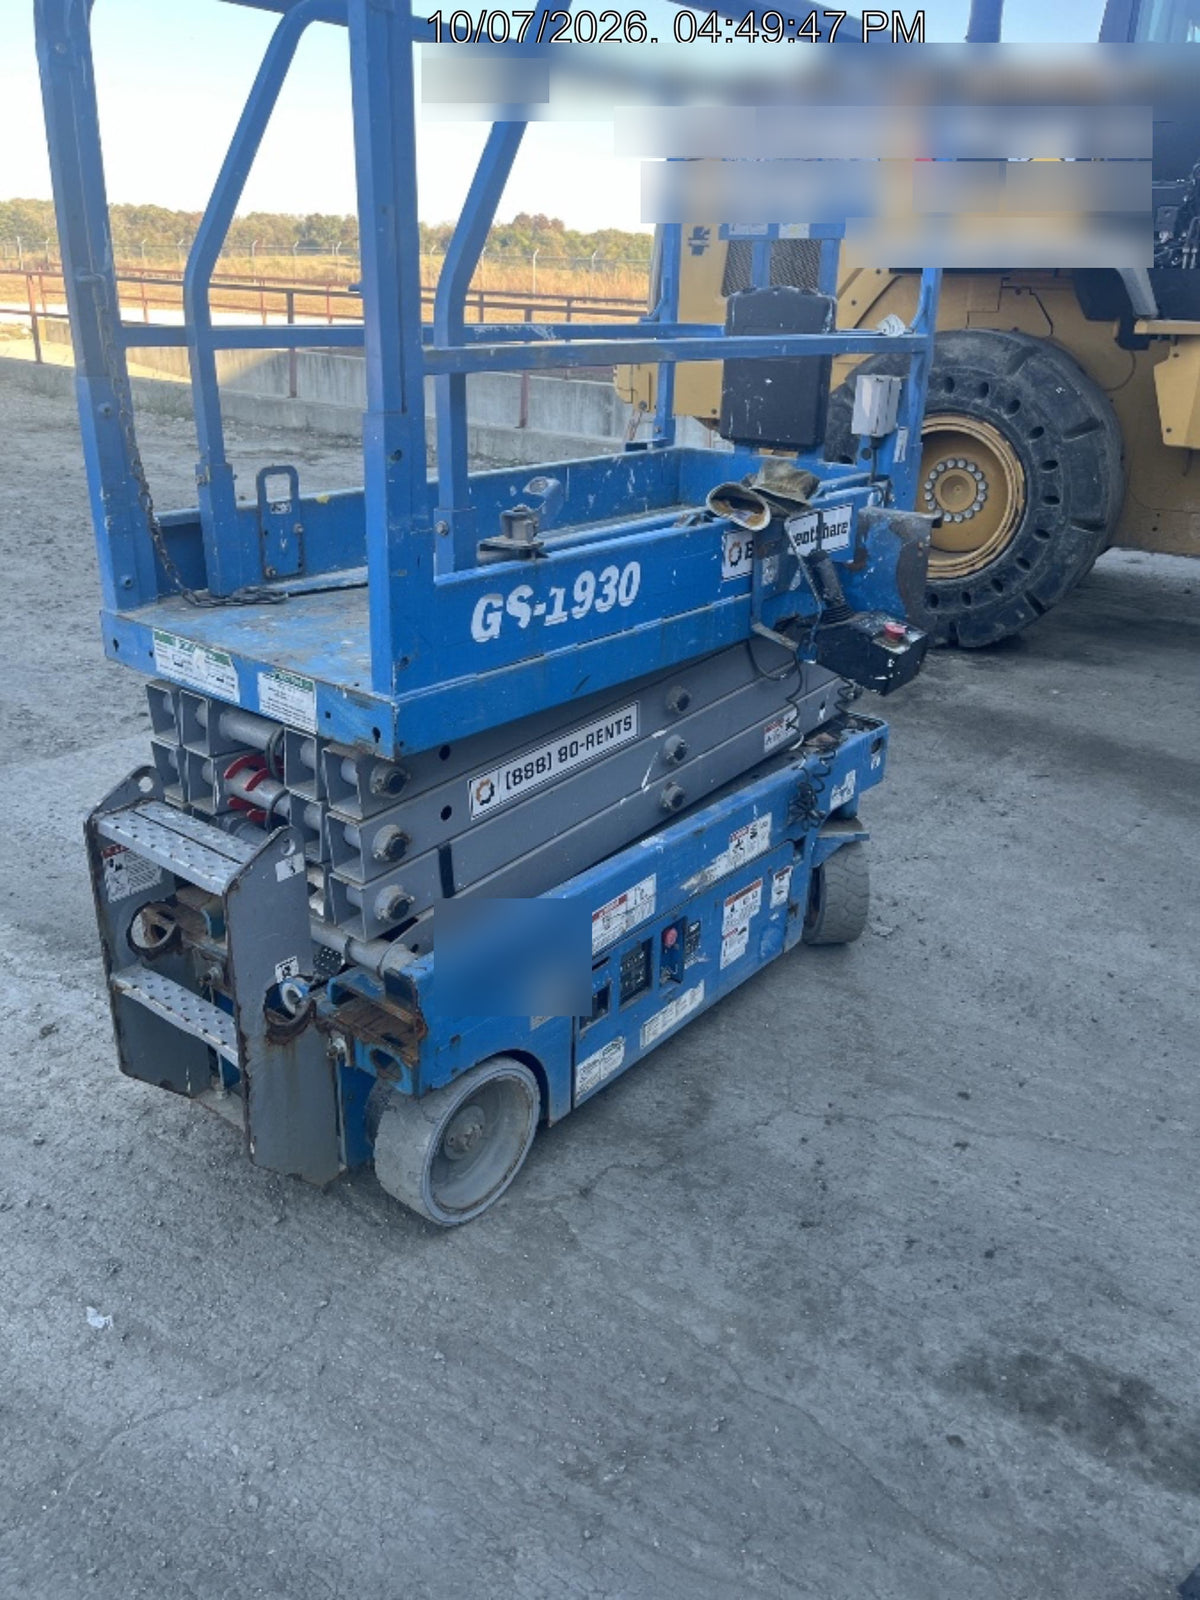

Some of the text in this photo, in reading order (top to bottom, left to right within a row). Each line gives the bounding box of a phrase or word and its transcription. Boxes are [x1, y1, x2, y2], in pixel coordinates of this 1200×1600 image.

[471, 561, 641, 643] GS-1930
[505, 715, 633, 791] (888) 80-RENTS
